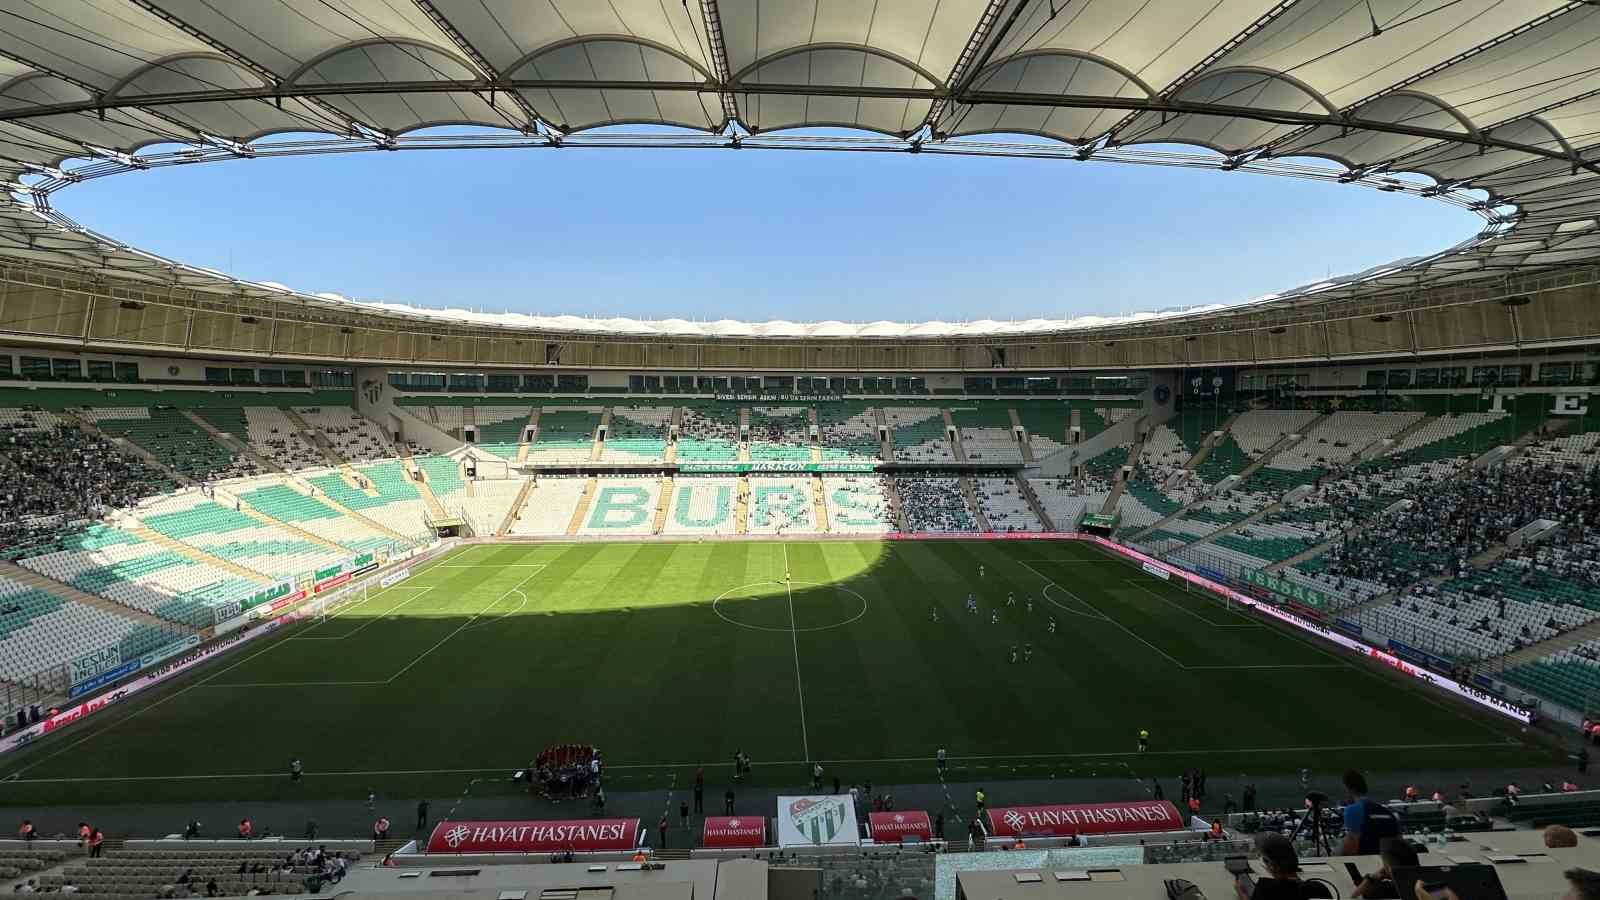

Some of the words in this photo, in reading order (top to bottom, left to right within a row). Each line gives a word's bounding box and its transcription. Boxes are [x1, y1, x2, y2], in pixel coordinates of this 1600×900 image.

[1028, 809, 1080, 827] HAYAT
[1080, 802, 1171, 824] HASTANESİ
[472, 826, 529, 843] HAYAT
[530, 821, 626, 842] HASTANESİ
[707, 828, 727, 837] HAYAT
[874, 823, 895, 832] HAYAT
